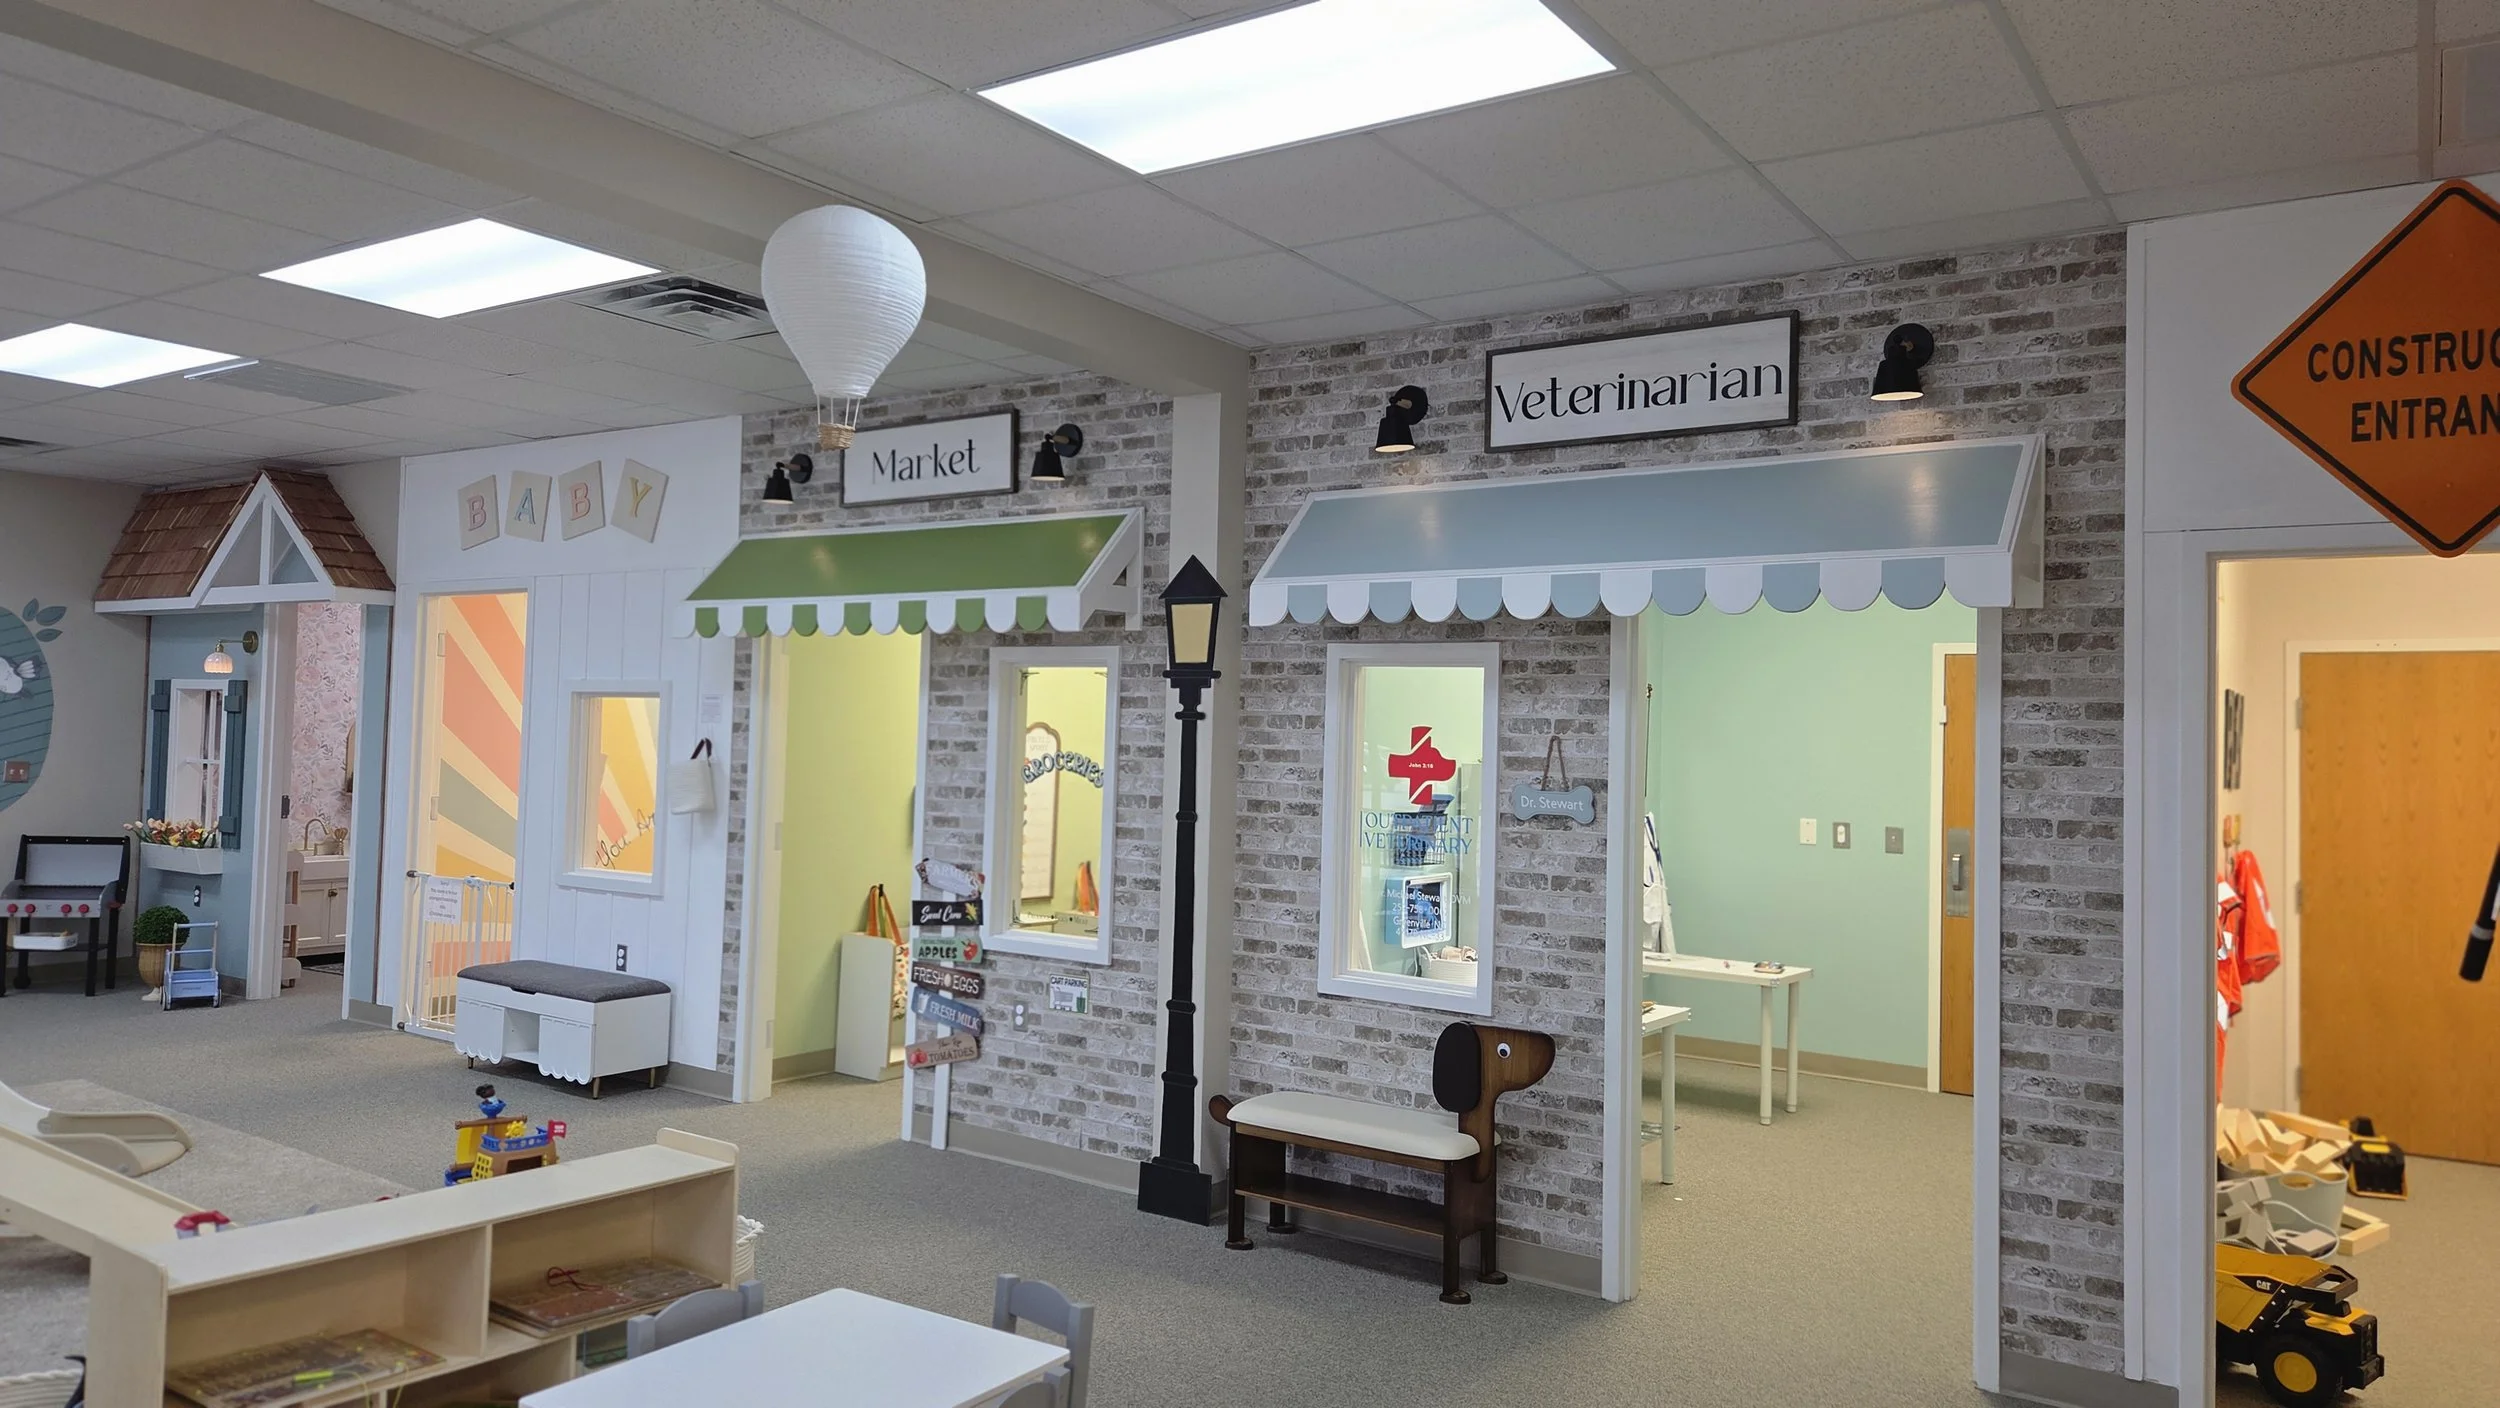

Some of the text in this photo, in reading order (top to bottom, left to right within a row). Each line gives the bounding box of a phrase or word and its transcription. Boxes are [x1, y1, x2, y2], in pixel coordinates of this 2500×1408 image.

[1494, 362, 1783, 424] Veterinarian
[2350, 393, 2500, 443] ENTRAN
[872, 439, 981, 485] Market
[467, 476, 653, 532] BABY
[1520, 795, 1584, 811] Dr. Stewart
[918, 945, 958, 959] APPLES
[913, 966, 979, 994] FRESH EGGS
[1051, 976, 1087, 989] CART PARKING
[930, 1001, 980, 1031] FRESH MILK
[929, 1047, 974, 1062] TOMATOES
[2256, 1279, 2271, 1291] CAT
